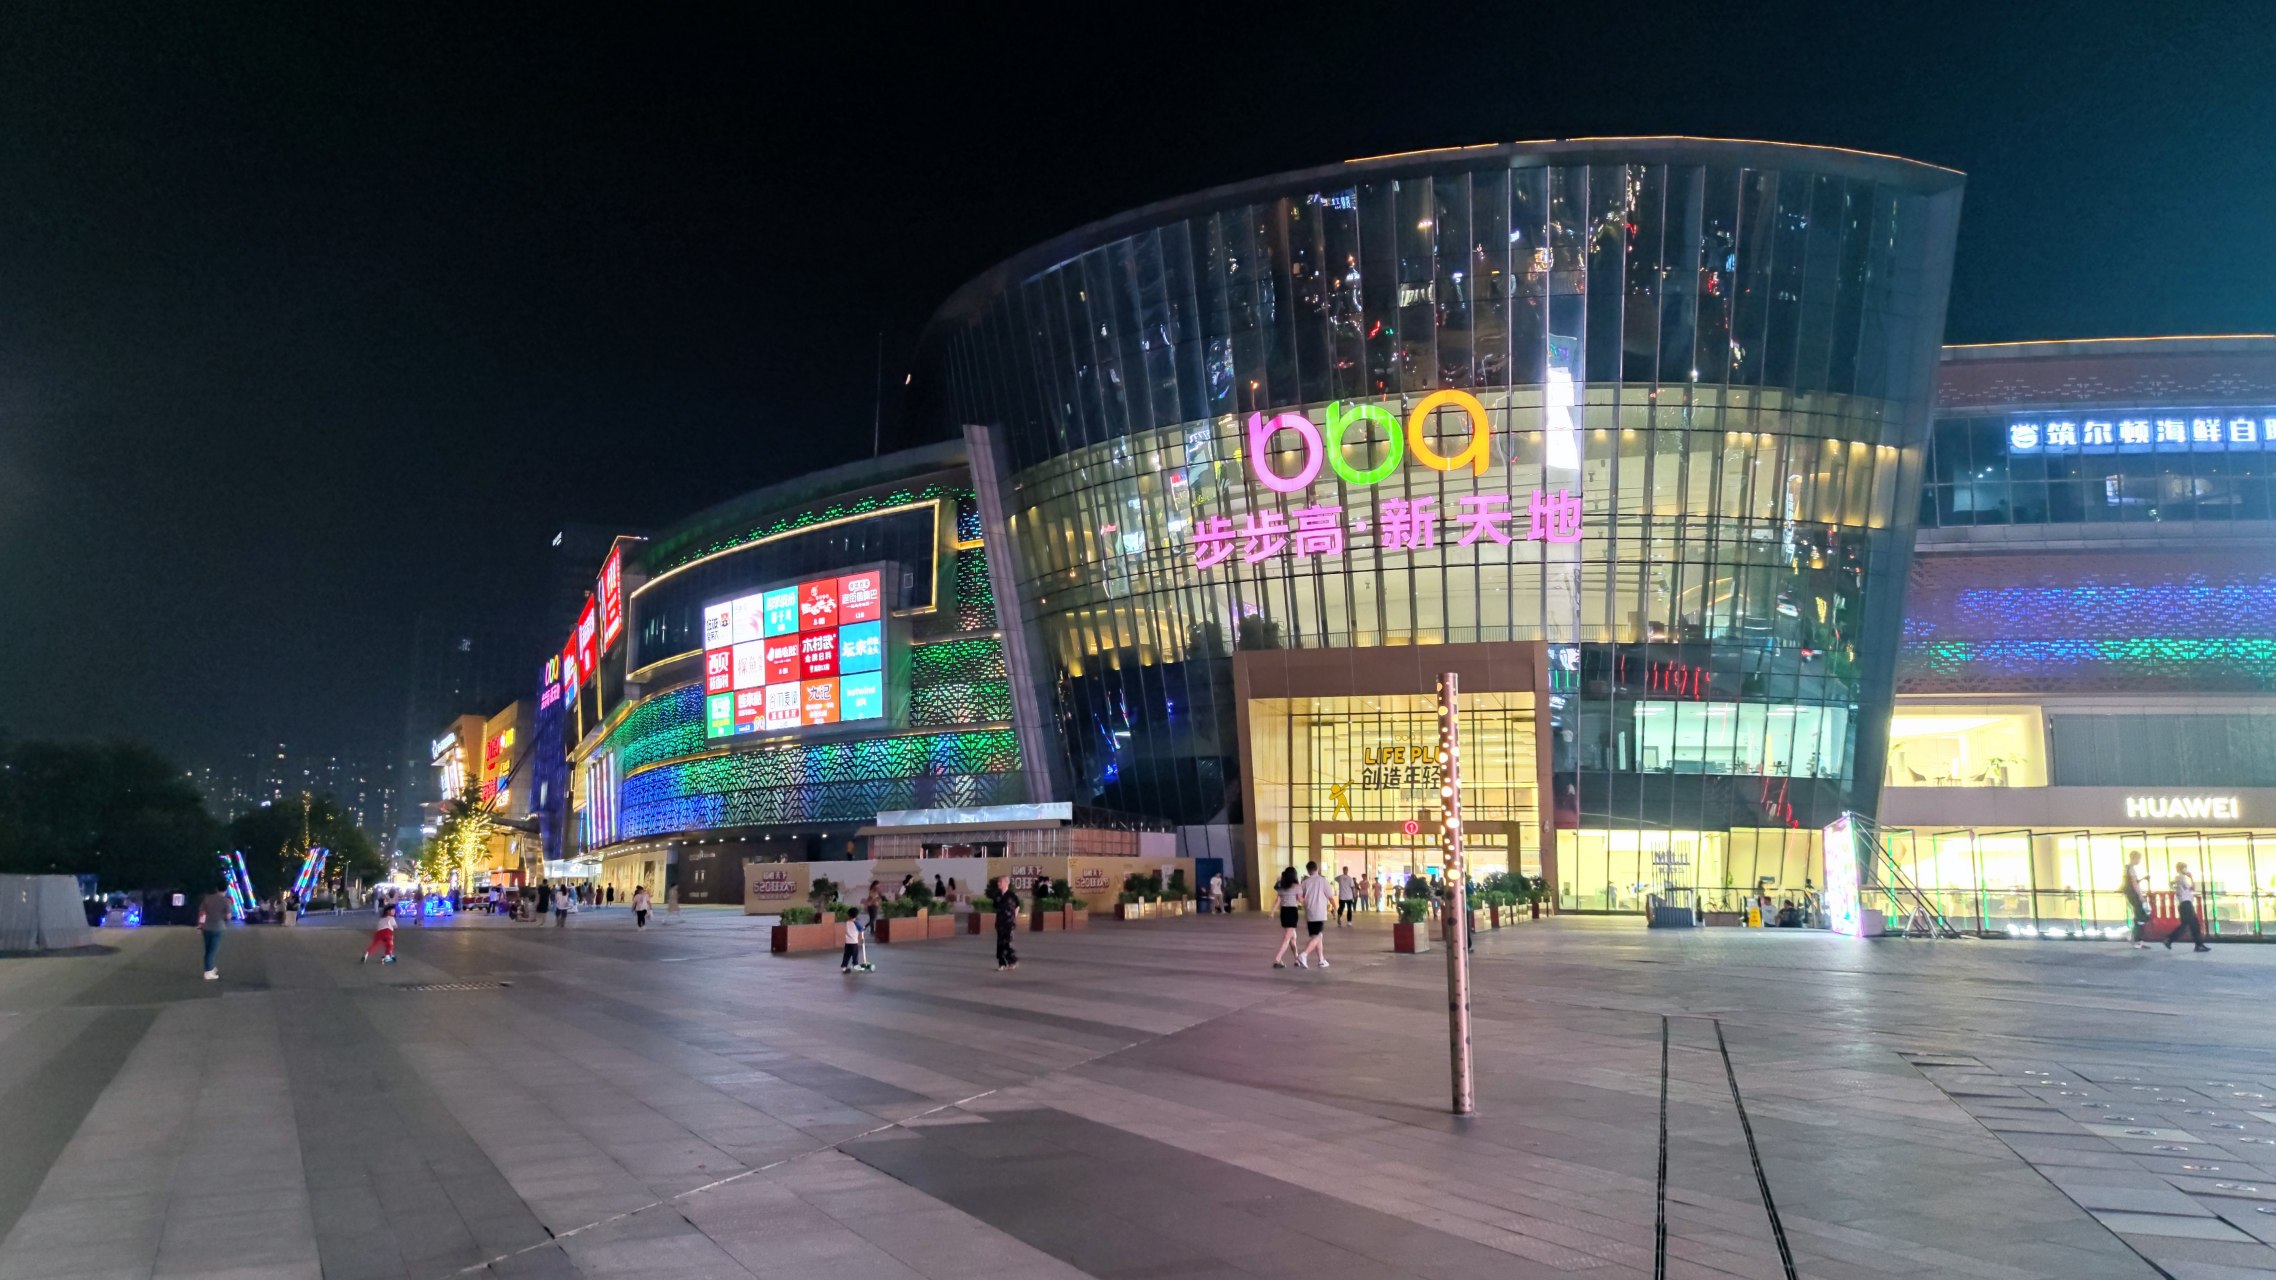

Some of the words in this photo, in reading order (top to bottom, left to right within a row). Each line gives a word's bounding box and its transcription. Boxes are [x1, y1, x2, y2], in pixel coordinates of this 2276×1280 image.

[1192, 489, 1584, 570] 步步高·新天地
[1364, 746, 1406, 765] LIFE
[2126, 797, 2240, 819] HUAWEI
